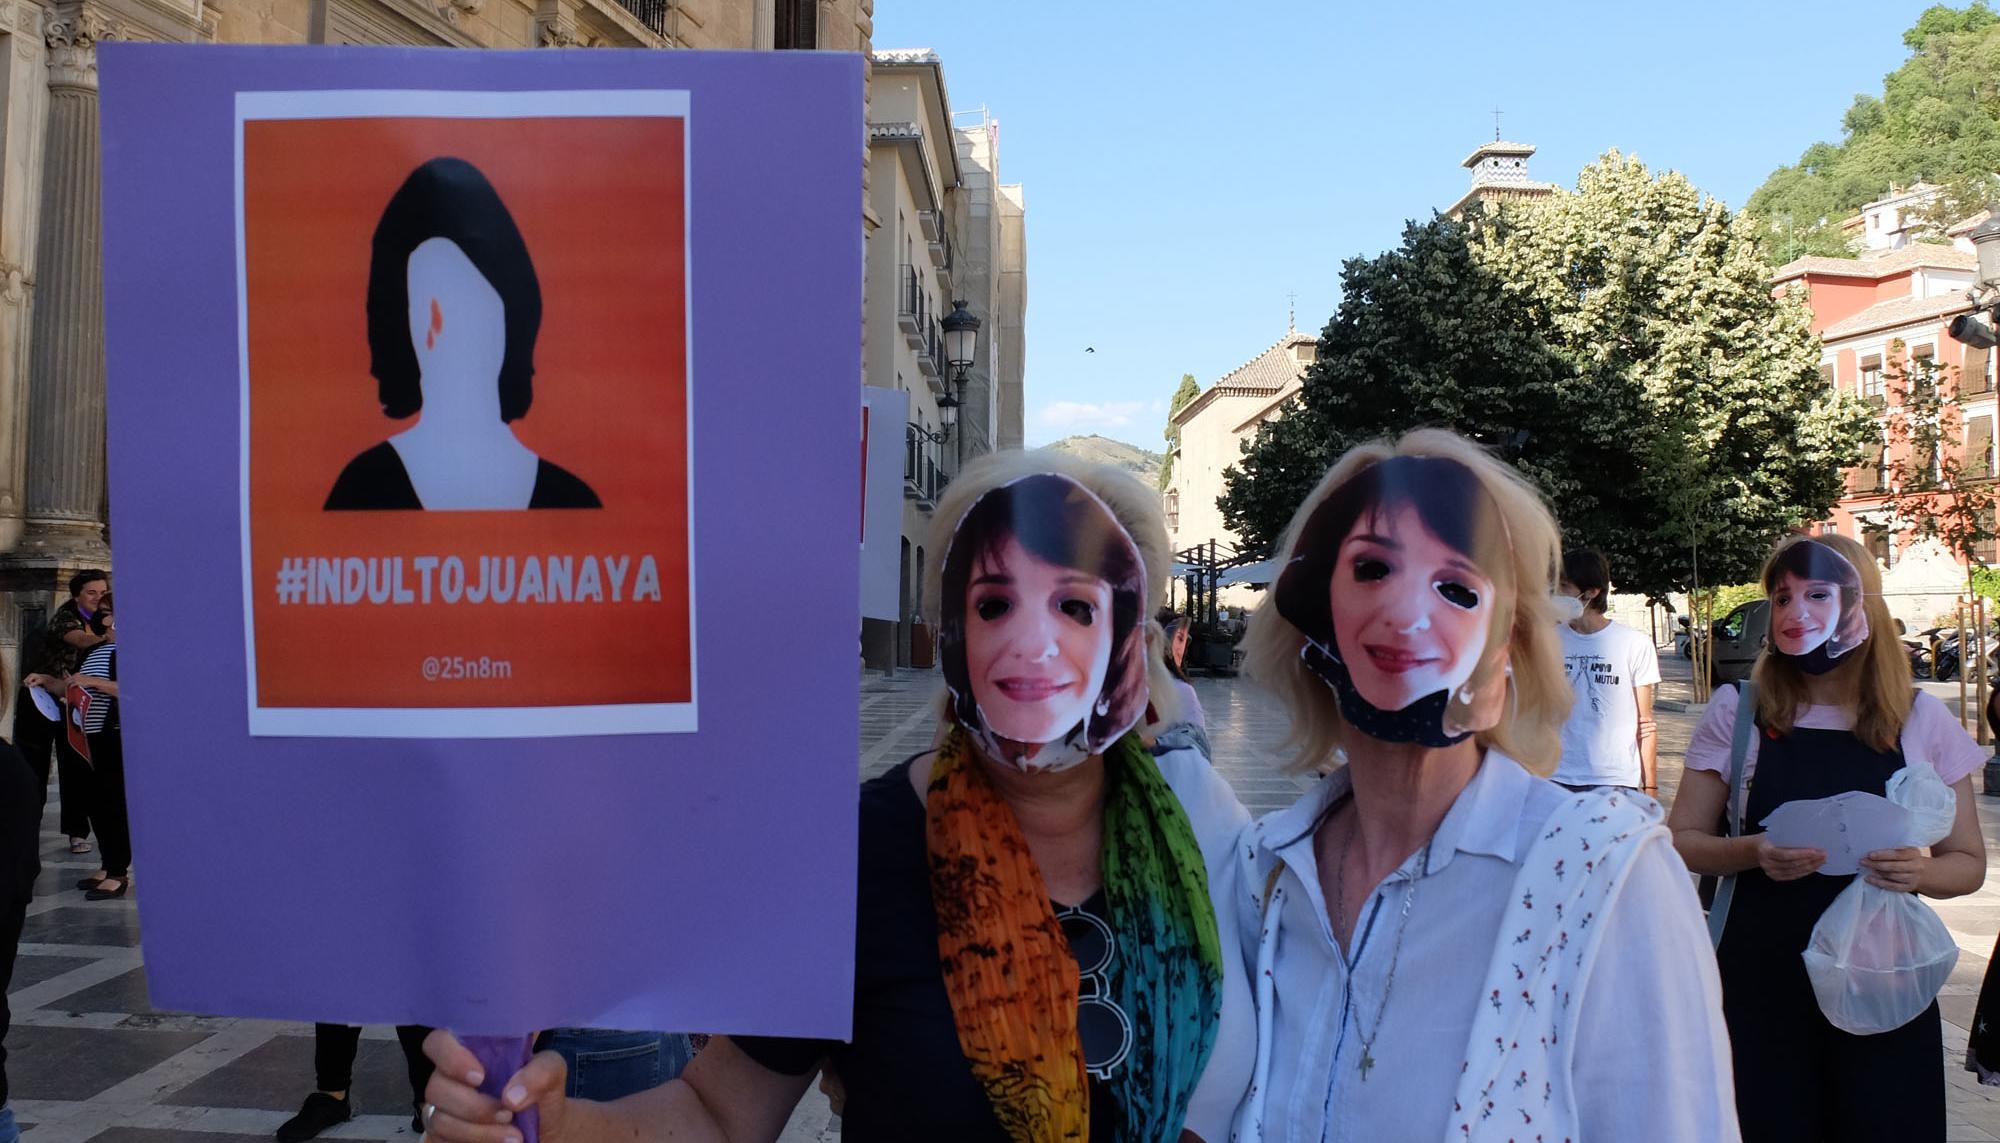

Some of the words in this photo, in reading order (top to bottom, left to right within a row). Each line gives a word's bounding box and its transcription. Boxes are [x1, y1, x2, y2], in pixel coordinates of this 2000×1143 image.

[276, 554, 662, 605] #INDULTOJUANAYA
[422, 656, 512, 681] @25n8m
[1590, 662, 1612, 673] APOYO
[1594, 674, 1620, 685] MUTUO
